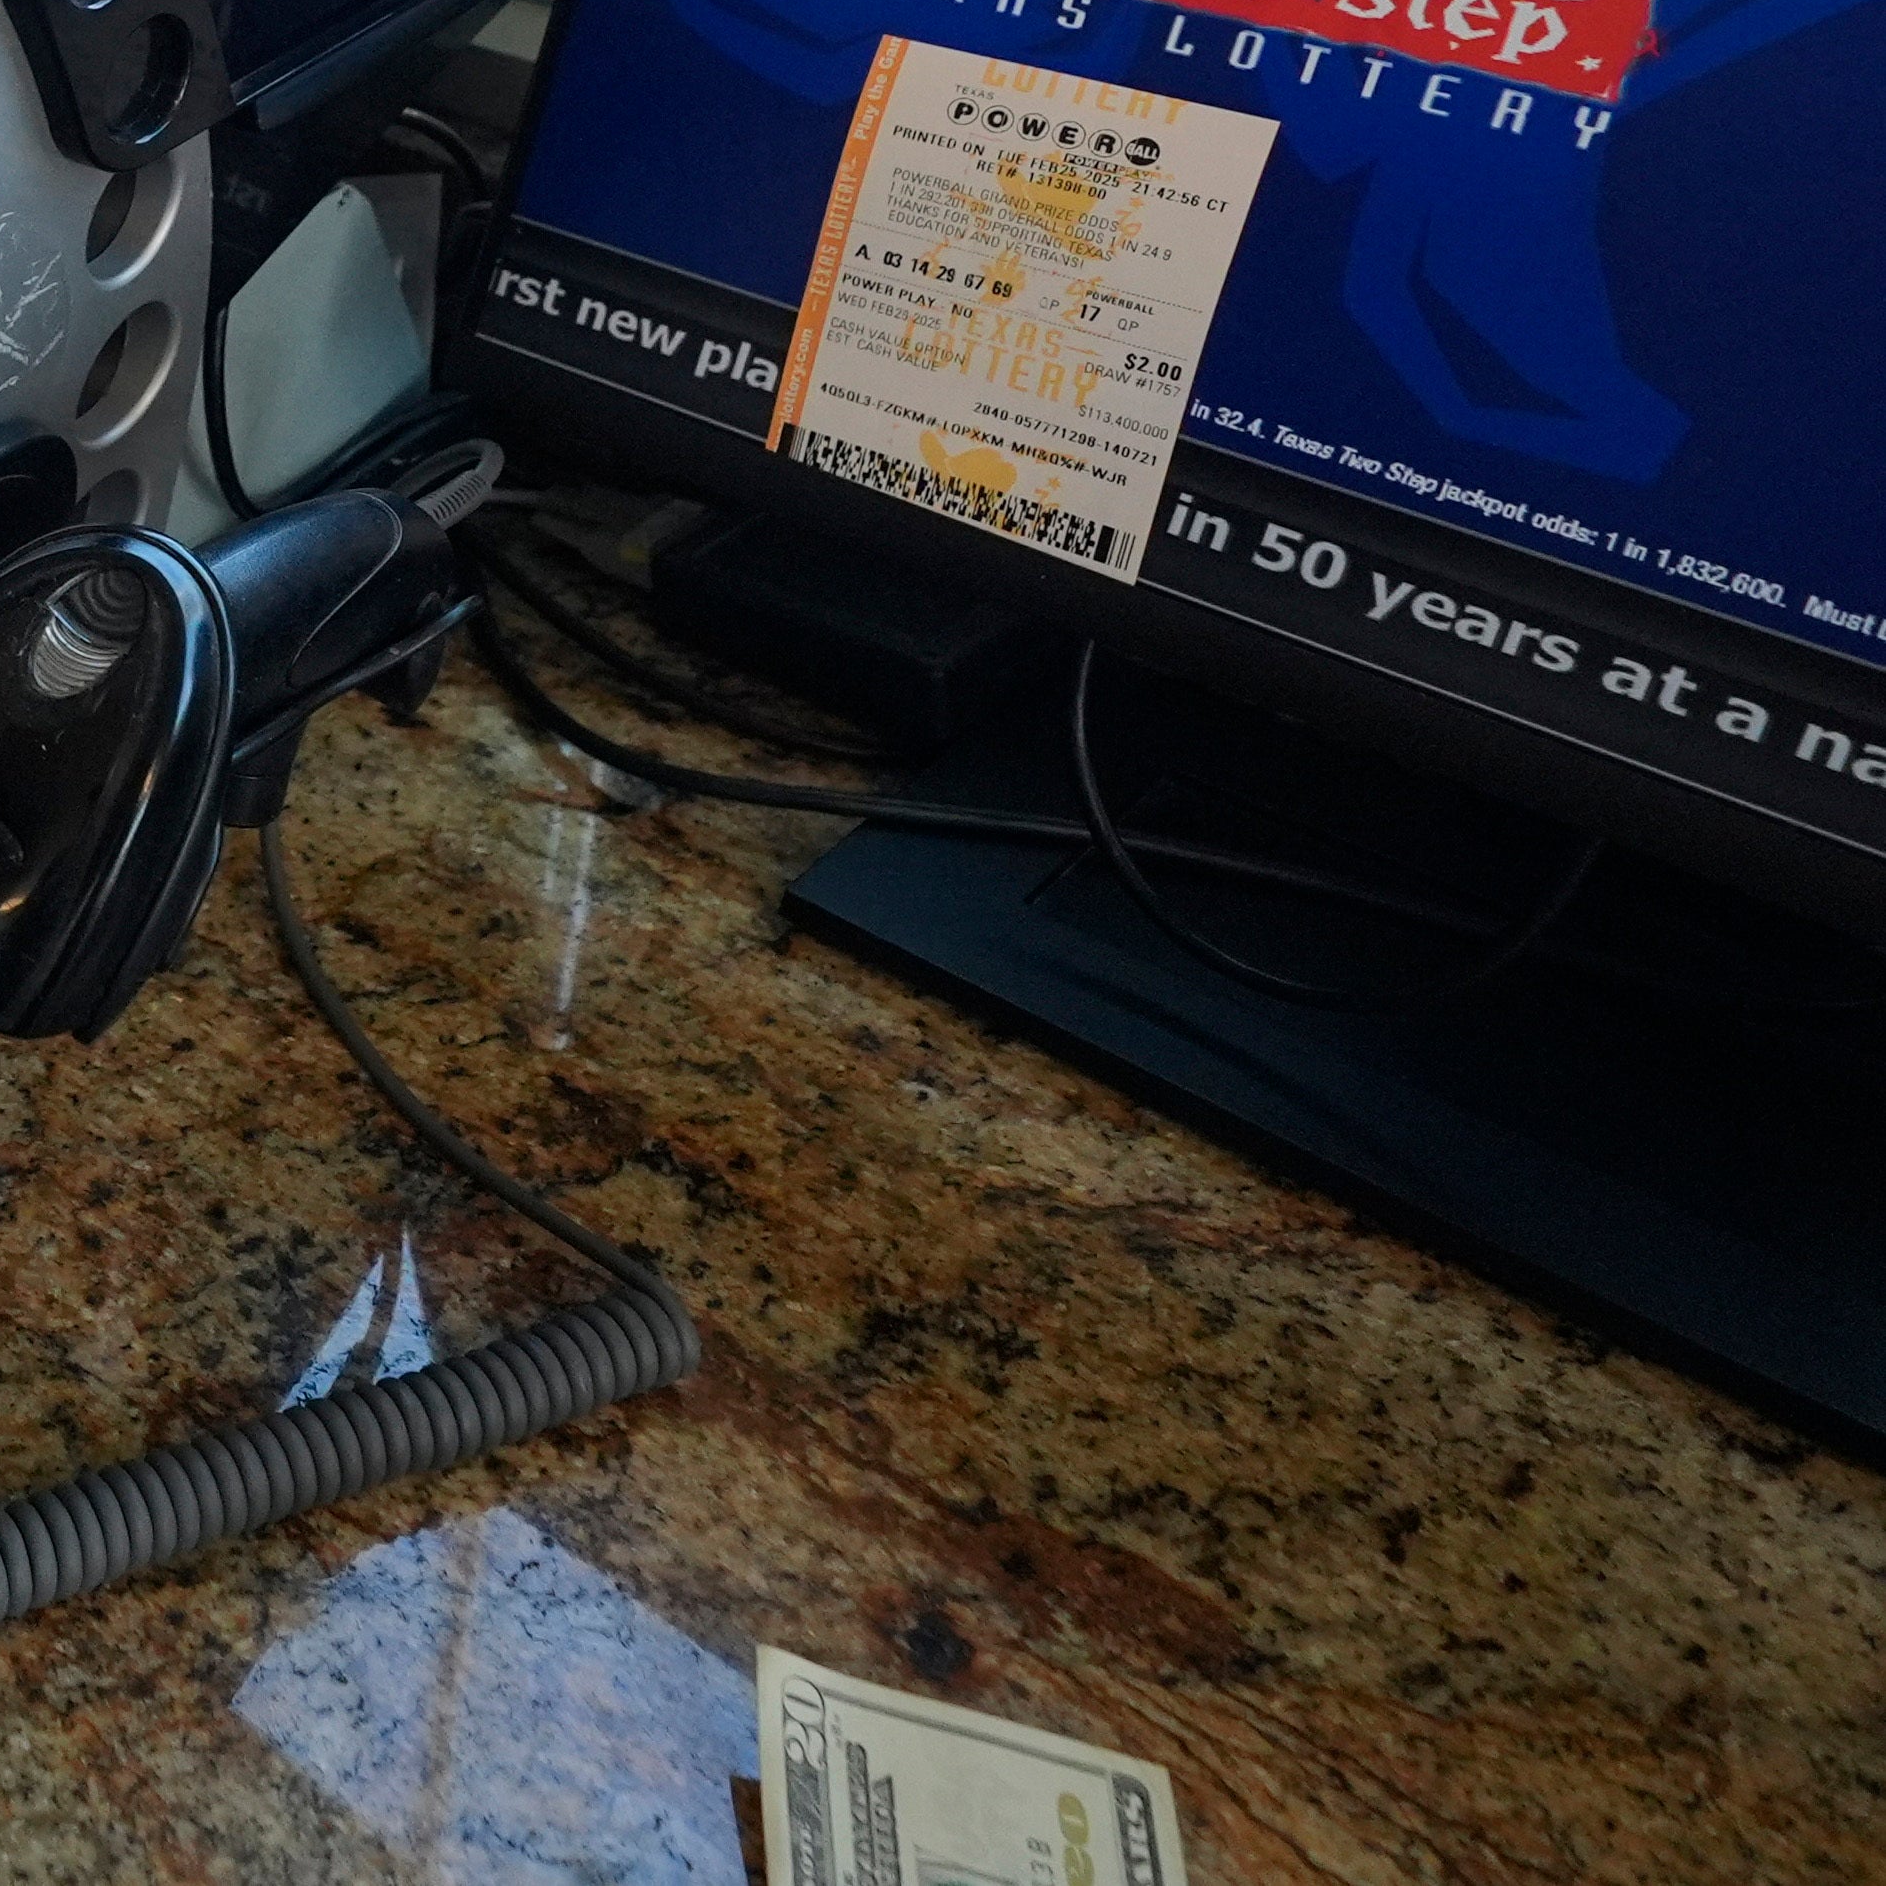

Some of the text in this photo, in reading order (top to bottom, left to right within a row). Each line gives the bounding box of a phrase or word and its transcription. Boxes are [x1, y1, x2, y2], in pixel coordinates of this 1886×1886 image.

[854, 101, 875, 142] Play
[866, 72, 889, 104] the
[954, 84, 995, 101] TEXAS
[1165, 14, 1615, 152] LOTTERY
[892, 125, 1230, 214] PRINTED ON TUE FEB25 2025 21:42:56 CT
[976, 159, 1018, 179] RET#
[892, 166, 1120, 232] POWERBALL GRAND PRIZE ODDS
[886, 194, 1115, 263] THANKS FOR SUPPORTING TEXAS
[888, 209, 966, 239] EDUCATION
[969, 229, 1001, 249] AND
[997, 206, 1138, 254] OVERALL ODDS IN
[837, 291, 868, 310] WED
[841, 271, 973, 319] POWER PLAY NO
[883, 250, 1061, 313] 03 14 29 67 69 QP
[1085, 288, 1156, 316] POWERBALL
[576, 296, 689, 357] new
[830, 316, 967, 366] CASH VALUE OPTION
[1080, 304, 1140, 332] 17 QP
[826, 330, 941, 371] EST CASH VALUE
[1123, 352, 1183, 382] $2.00
[1084, 361, 1182, 398] DRAW #1757
[1190, 398, 1528, 523] in 32.4. Texas Two Step jackpot
[1166, 492, 1580, 672] in 50 years
[1531, 509, 1875, 640] odds: 1 in 1,832,600. Must
[1601, 654, 1698, 717] at
[1715, 695, 1770, 743] a
[781, 1674, 828, 1770] 20
